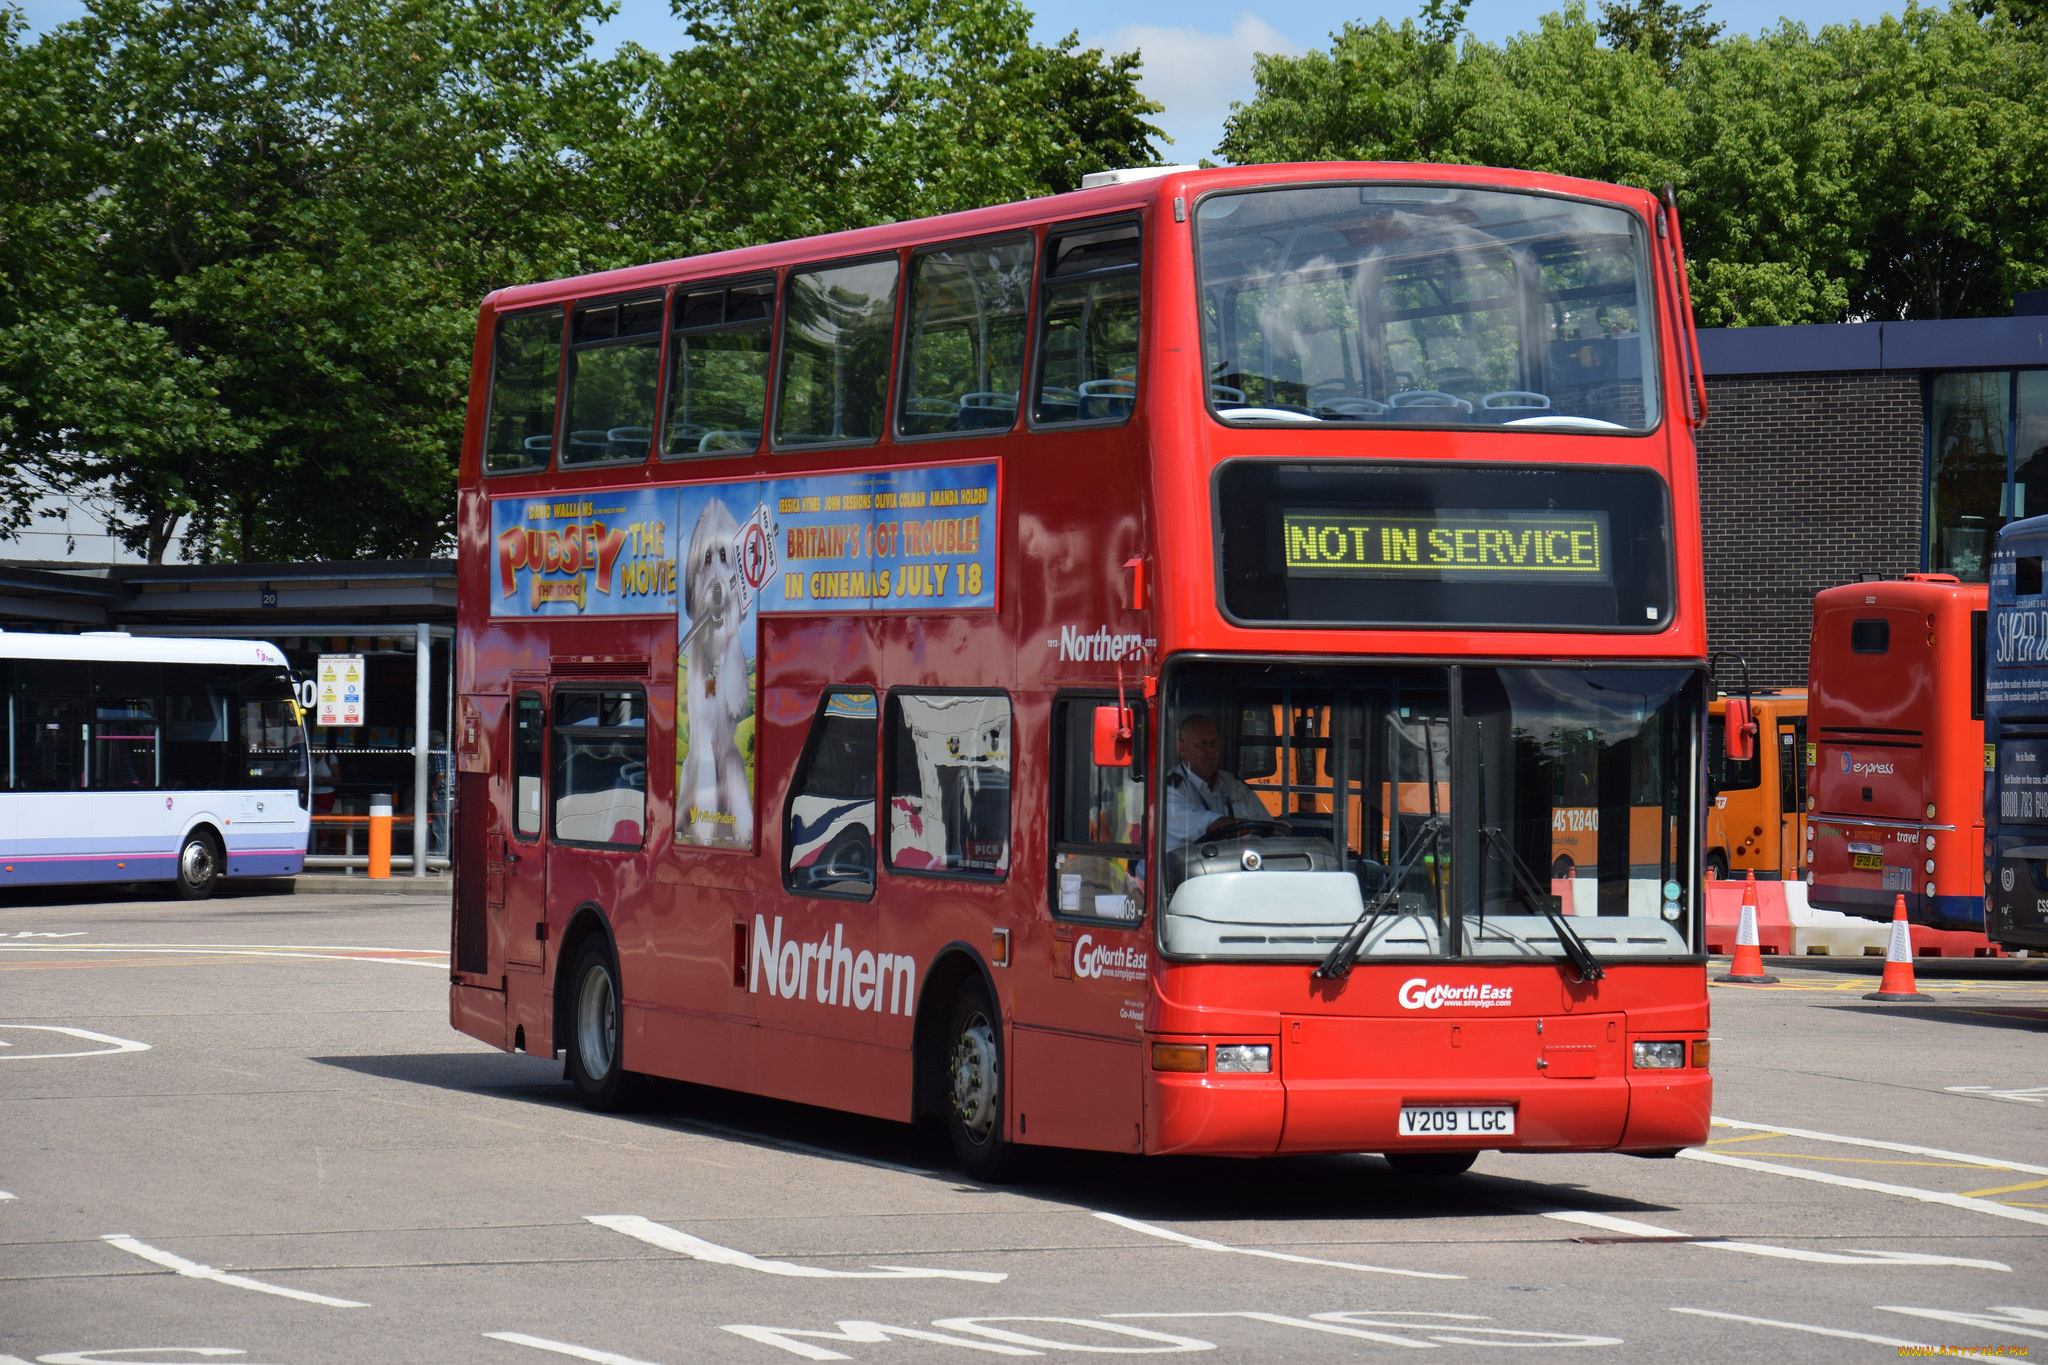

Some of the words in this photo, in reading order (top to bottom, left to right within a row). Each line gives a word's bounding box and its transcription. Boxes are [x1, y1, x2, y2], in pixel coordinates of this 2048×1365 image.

[529, 504, 552, 520] DAVID
[553, 502, 594, 519] WALLIAMS
[778, 497, 801, 514] JESSICA
[802, 496, 821, 512] HYNES
[824, 495, 841, 511] JOHN
[842, 493, 872, 511] SESSIONS
[874, 492, 898, 509] OLIVIA
[899, 491, 926, 508] COLMAN
[929, 489, 959, 507] AMANDA
[960, 487, 988, 505] HOLDEN
[629, 521, 666, 558] THE
[766, 533, 775, 567] DOGS
[787, 523, 860, 560] BRITAIN'S
[865, 521, 899, 558] GOT
[902, 515, 980, 556] TROUBLE!
[1290, 526, 1369, 561] NOT
[1381, 527, 1418, 561] IN
[1428, 528, 1593, 564] SERVICE
[497, 520, 628, 598] PUDSEY
[735, 544, 748, 601] ALLOWED
[538, 584, 554, 597] THE
[556, 584, 580, 597] DOG
[621, 558, 677, 598] MOVIE
[784, 571, 805, 600] IN
[810, 569, 891, 599] CINEMAS
[895, 562, 949, 597] JULY
[956, 561, 983, 596] 18
[263, 594, 276, 604] 20
[1060, 624, 1142, 661] Northern
[1997, 611, 2037, 663] SUPER
[2001, 791, 2018, 817] 0800
[2021, 791, 2033, 818] 783
[1818, 827, 1843, 840] greener
[1853, 829, 1883, 841] smarter
[1897, 830, 1920, 844] travel
[974, 844, 1000, 855] PICK
[749, 913, 916, 1017] Northern
[1096, 944, 1125, 967] North
[1125, 947, 1147, 970] East
[1434, 984, 1479, 999] North
[1480, 984, 1513, 999] East
[1443, 1000, 1511, 1009] www.simplygo.com
[1120, 1008, 1144, 1021] Go-Ahead
[1405, 1110, 1458, 1132] V209
[1467, 1110, 1507, 1131] LGC
